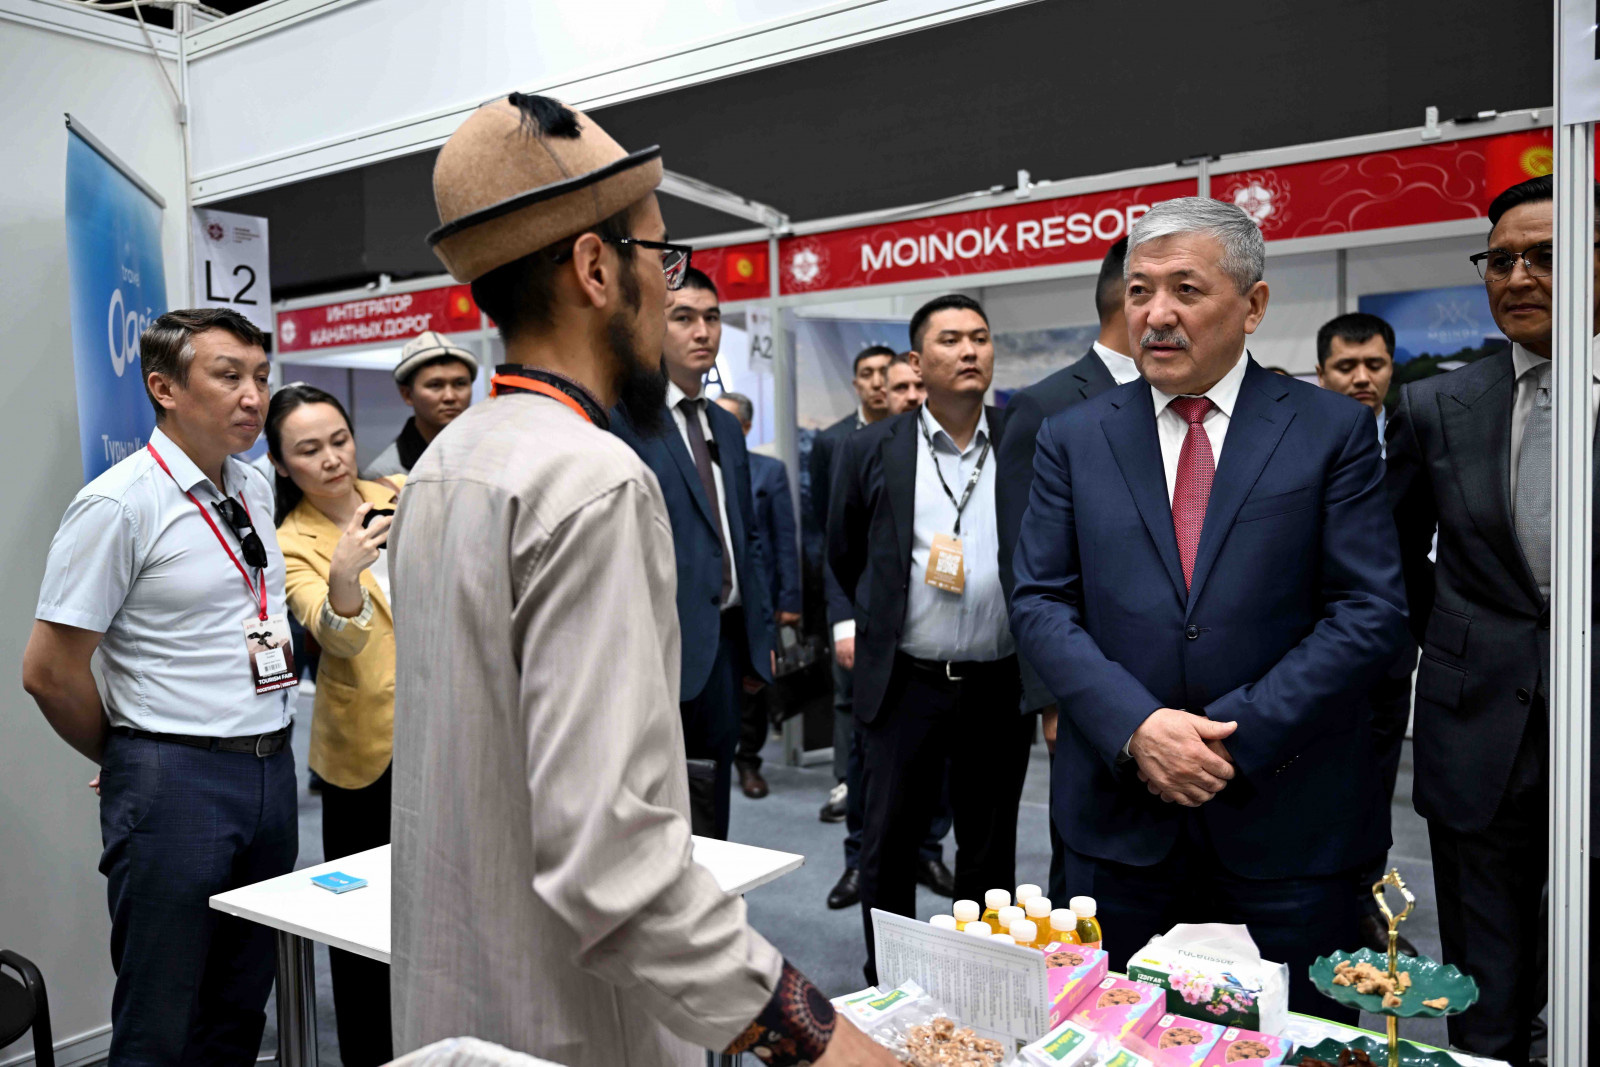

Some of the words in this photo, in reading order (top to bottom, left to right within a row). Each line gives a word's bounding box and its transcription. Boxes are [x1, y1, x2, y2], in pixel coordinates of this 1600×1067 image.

[861, 223, 1009, 272] MOINOK
[1016, 202, 1165, 251] RESOR
[205, 260, 258, 306] L2
[326, 294, 413, 323] ИНТЕГРАТОР
[310, 321, 383, 346] КАНАТНЫХ
[383, 312, 433, 337] ДОРОГ
[750, 334, 774, 360] A2
[258, 676, 281, 685] TOURISM
[282, 672, 293, 680] FAIR
